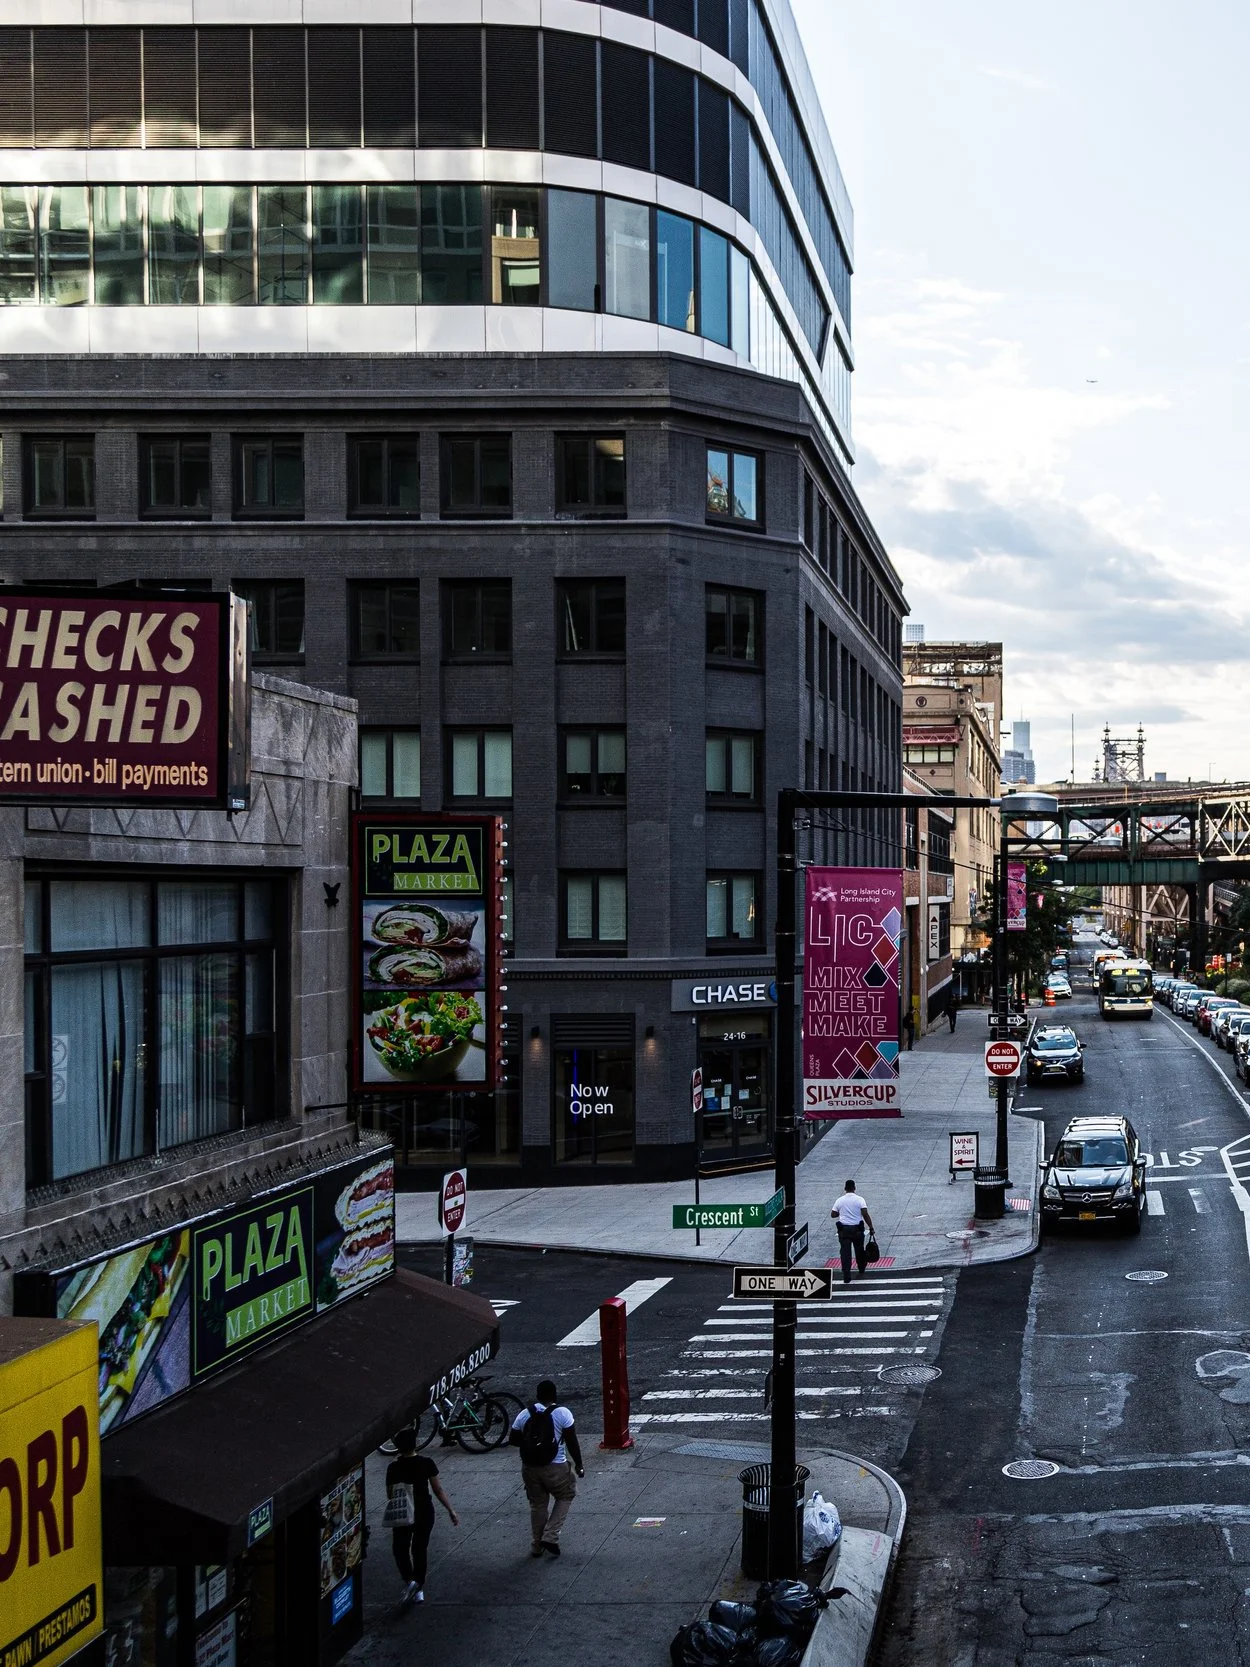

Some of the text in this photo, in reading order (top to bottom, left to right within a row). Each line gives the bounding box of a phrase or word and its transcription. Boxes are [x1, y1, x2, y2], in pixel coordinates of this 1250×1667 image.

[0, 607, 200, 674] HECKS
[0, 680, 203, 744] ASHED
[122, 761, 208, 790] payments
[372, 833, 471, 865] PLAZA
[394, 873, 476, 890] MARKET
[840, 887, 897, 897] Long Island City
[840, 895, 881, 904] Partnership
[809, 906, 873, 960] LIC
[809, 958, 863, 989] MIX
[691, 983, 766, 1005] CHASE
[806, 990, 886, 1013] MEET
[723, 1031, 746, 1041] 24-16
[808, 1014, 890, 1038] MAKE
[569, 1083, 610, 1098] Now
[806, 1084, 896, 1105] SILVERCUP
[569, 1100, 614, 1119] Open
[827, 1099, 873, 1107] STUDIOS
[446, 1181, 464, 1196] DO NOT
[447, 1208, 462, 1223] ENTER
[685, 1207, 744, 1226] Crescent
[749, 1205, 759, 1217] St
[201, 1205, 307, 1301] PLAZA
[748, 1277, 818, 1290] ONE WAY
[226, 1278, 309, 1348] MARKET
[429, 1342, 491, 1405] 718.786.8200
[250, 1504, 271, 1529] PLAZA
[39, 1594, 91, 1653] PRESTAMOS
[5, 1636, 33, 1667] PAWN
